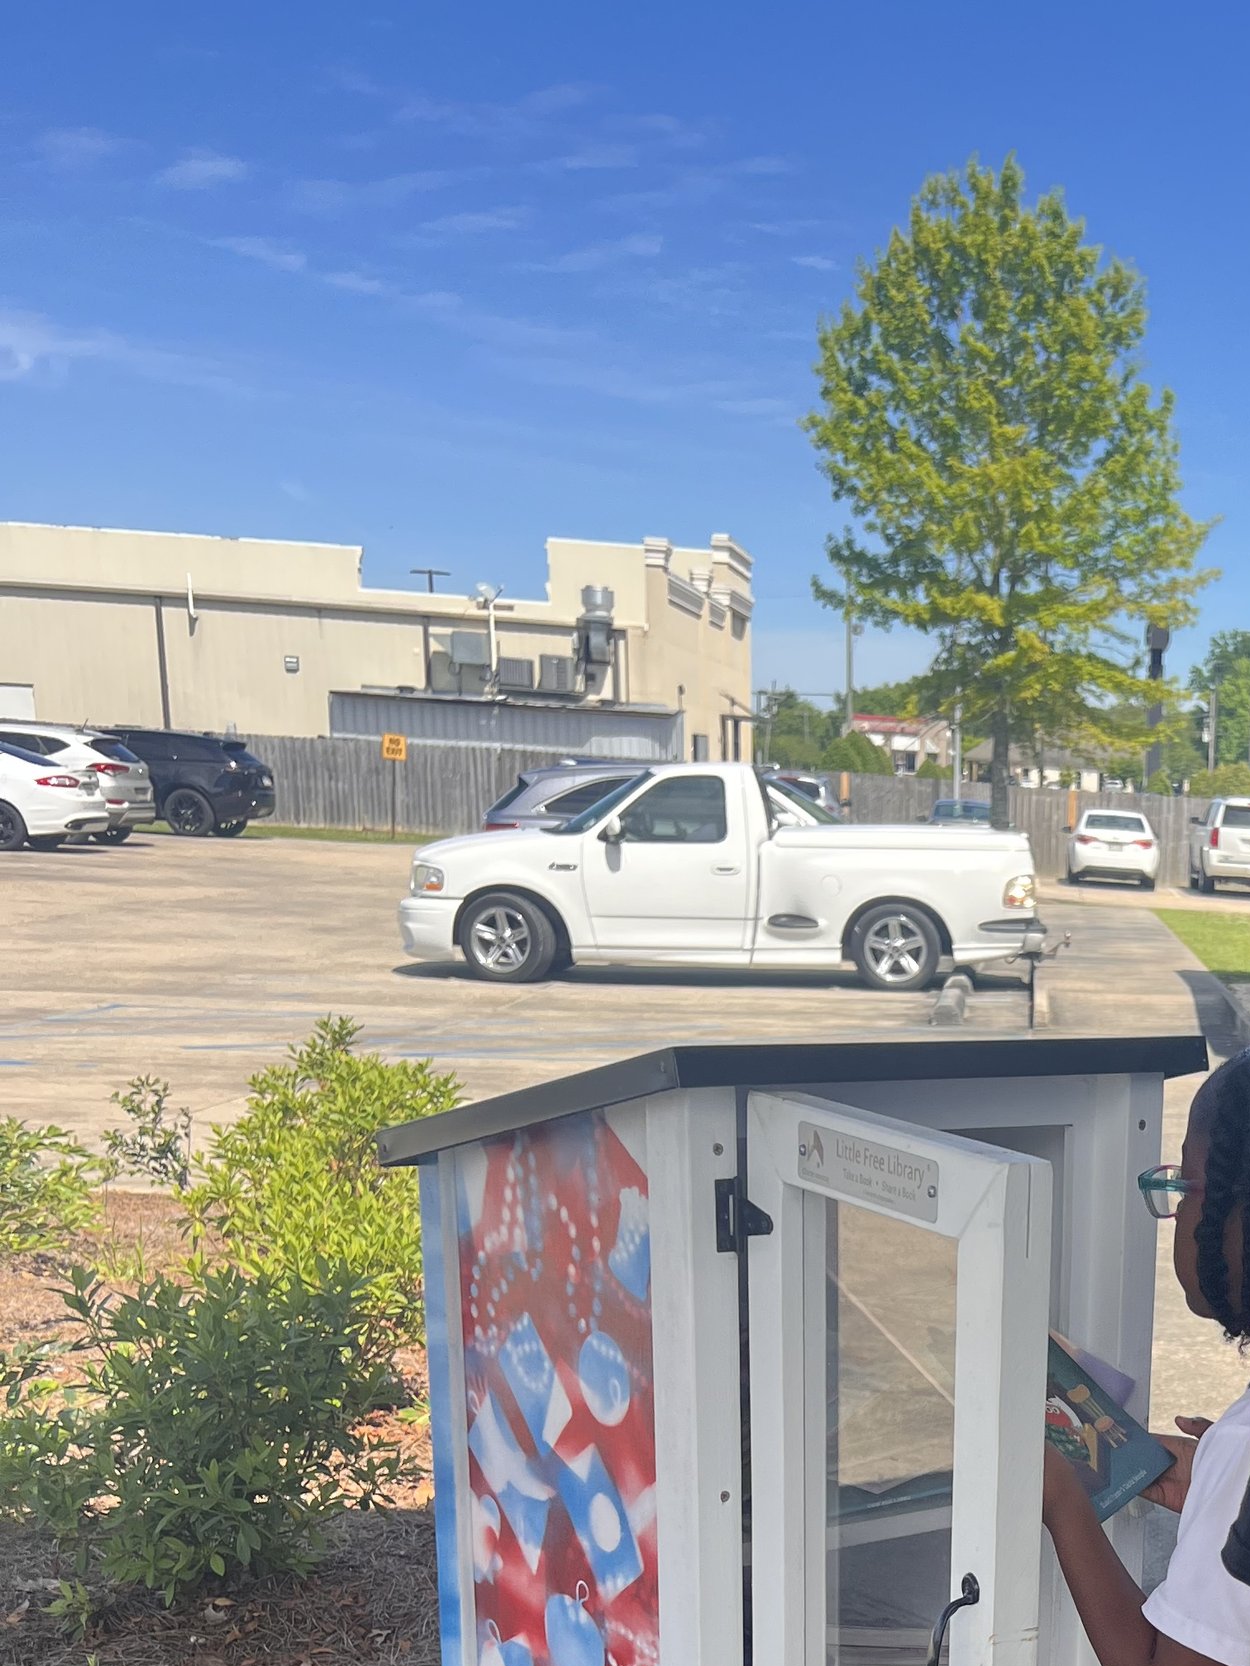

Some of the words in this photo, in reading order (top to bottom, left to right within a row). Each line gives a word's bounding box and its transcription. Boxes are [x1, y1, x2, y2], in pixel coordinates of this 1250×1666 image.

[836, 1138, 861, 1164] Little
[863, 1147, 885, 1172] Free
[887, 1154, 925, 1190] Library
[859, 1174, 873, 1187] Book
[881, 1180, 898, 1195] Share
[902, 1188, 916, 1201] Book
